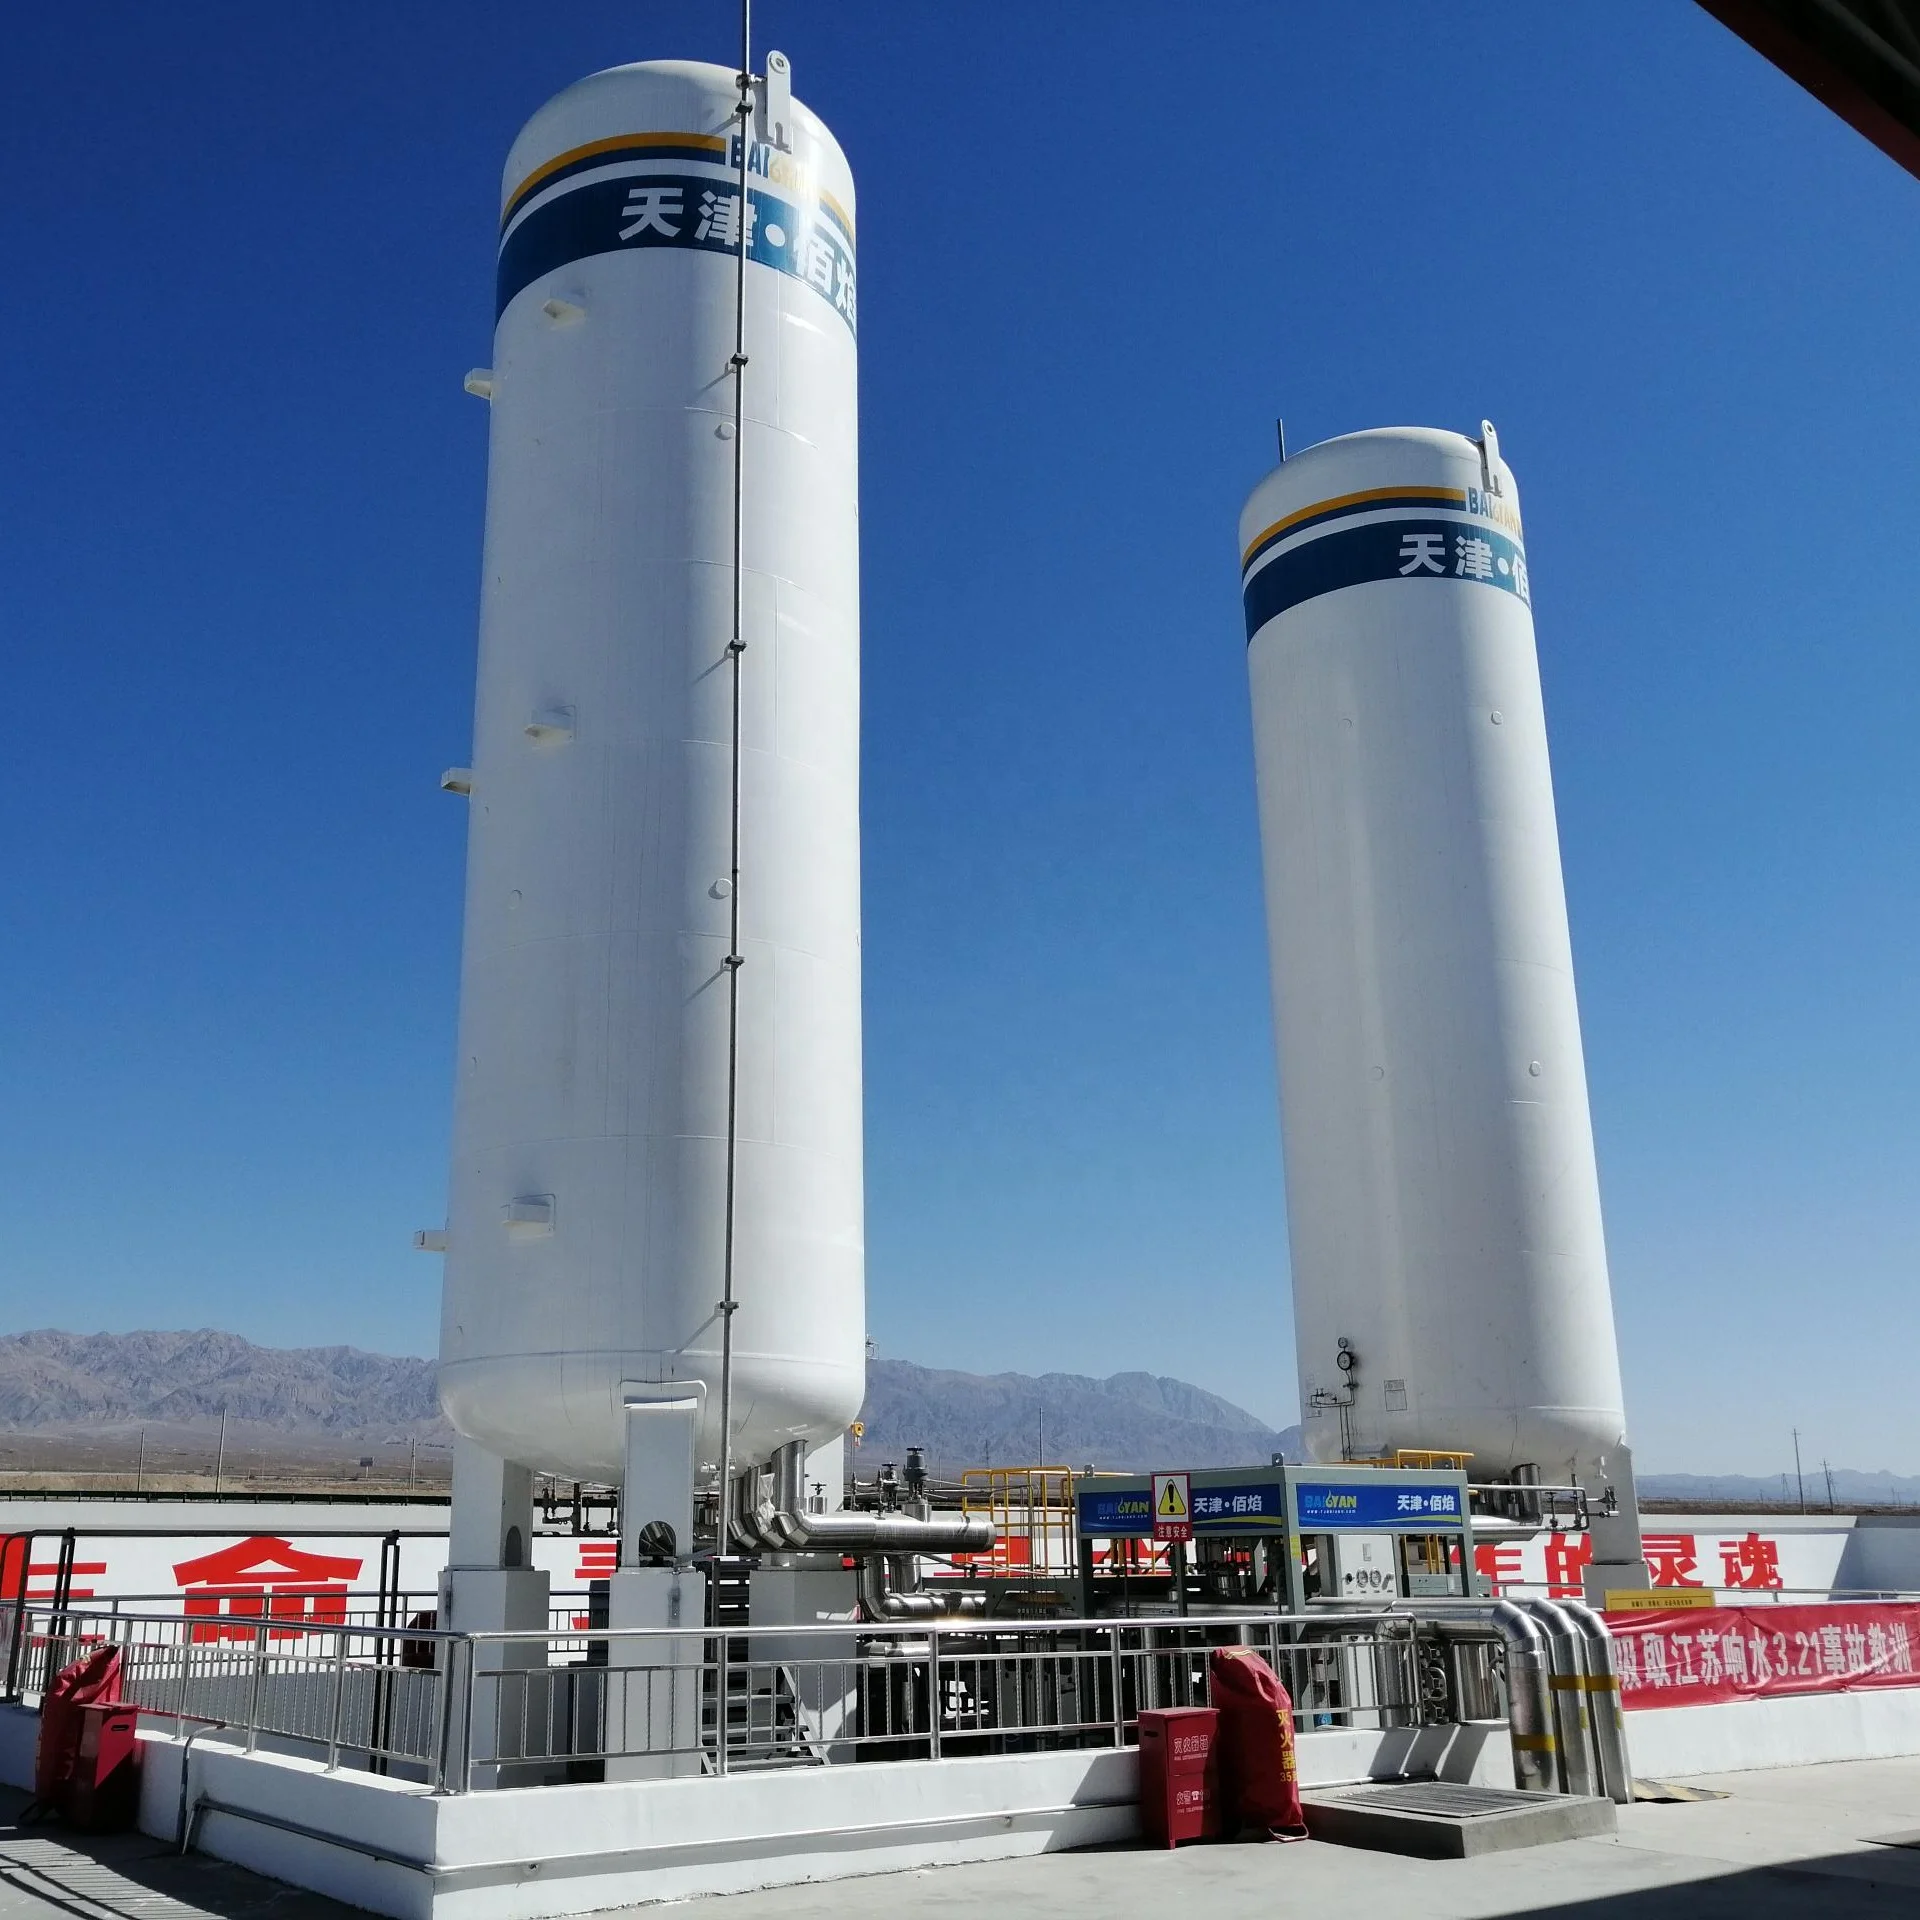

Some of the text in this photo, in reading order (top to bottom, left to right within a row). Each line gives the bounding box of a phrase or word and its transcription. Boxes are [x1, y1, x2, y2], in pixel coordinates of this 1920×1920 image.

[1157, 1525, 1188, 1538] 注意安全
[1276, 1709, 1296, 1770] 灭火器
